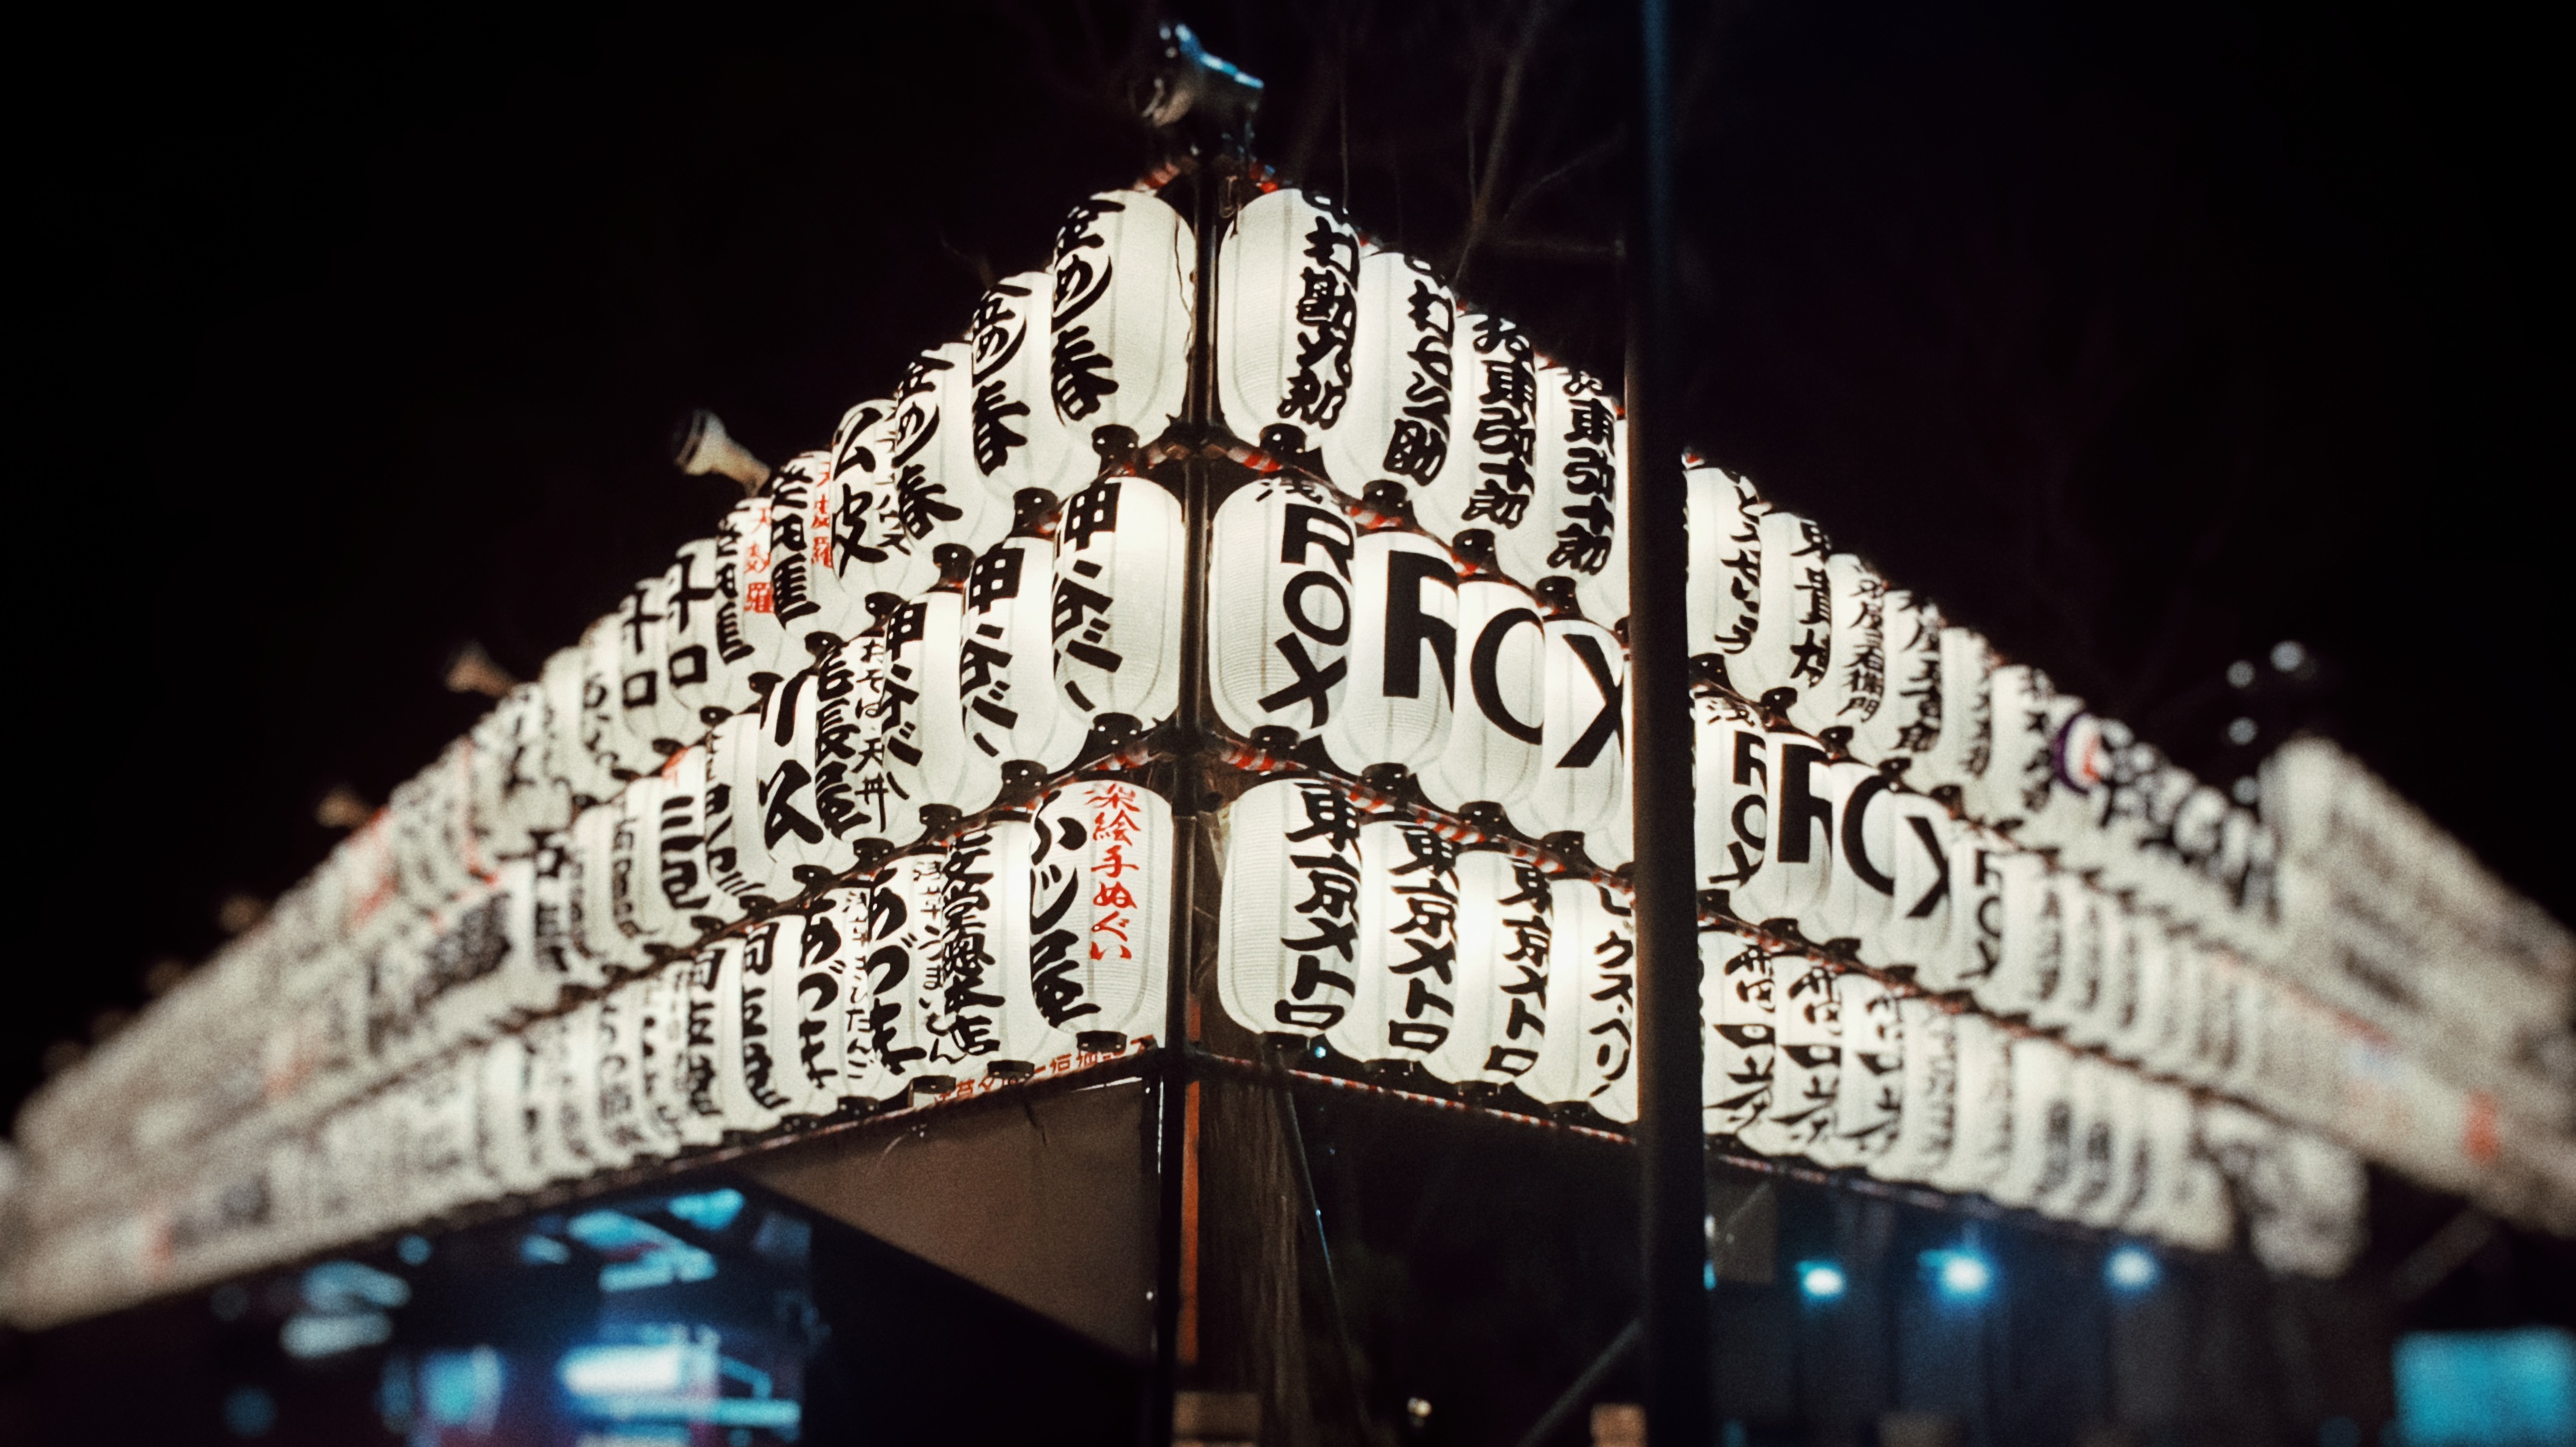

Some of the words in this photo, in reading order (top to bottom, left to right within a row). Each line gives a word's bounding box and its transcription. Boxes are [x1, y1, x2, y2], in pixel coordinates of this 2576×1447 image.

[1257, 502, 1355, 729] ROX
[1031, 790, 1101, 1027] ふじ屋
[1274, 782, 1362, 1031] 東京メトロ
[1388, 825, 1460, 1053] 東京メトロ
[1483, 857, 1554, 1077] 東京メトロ
